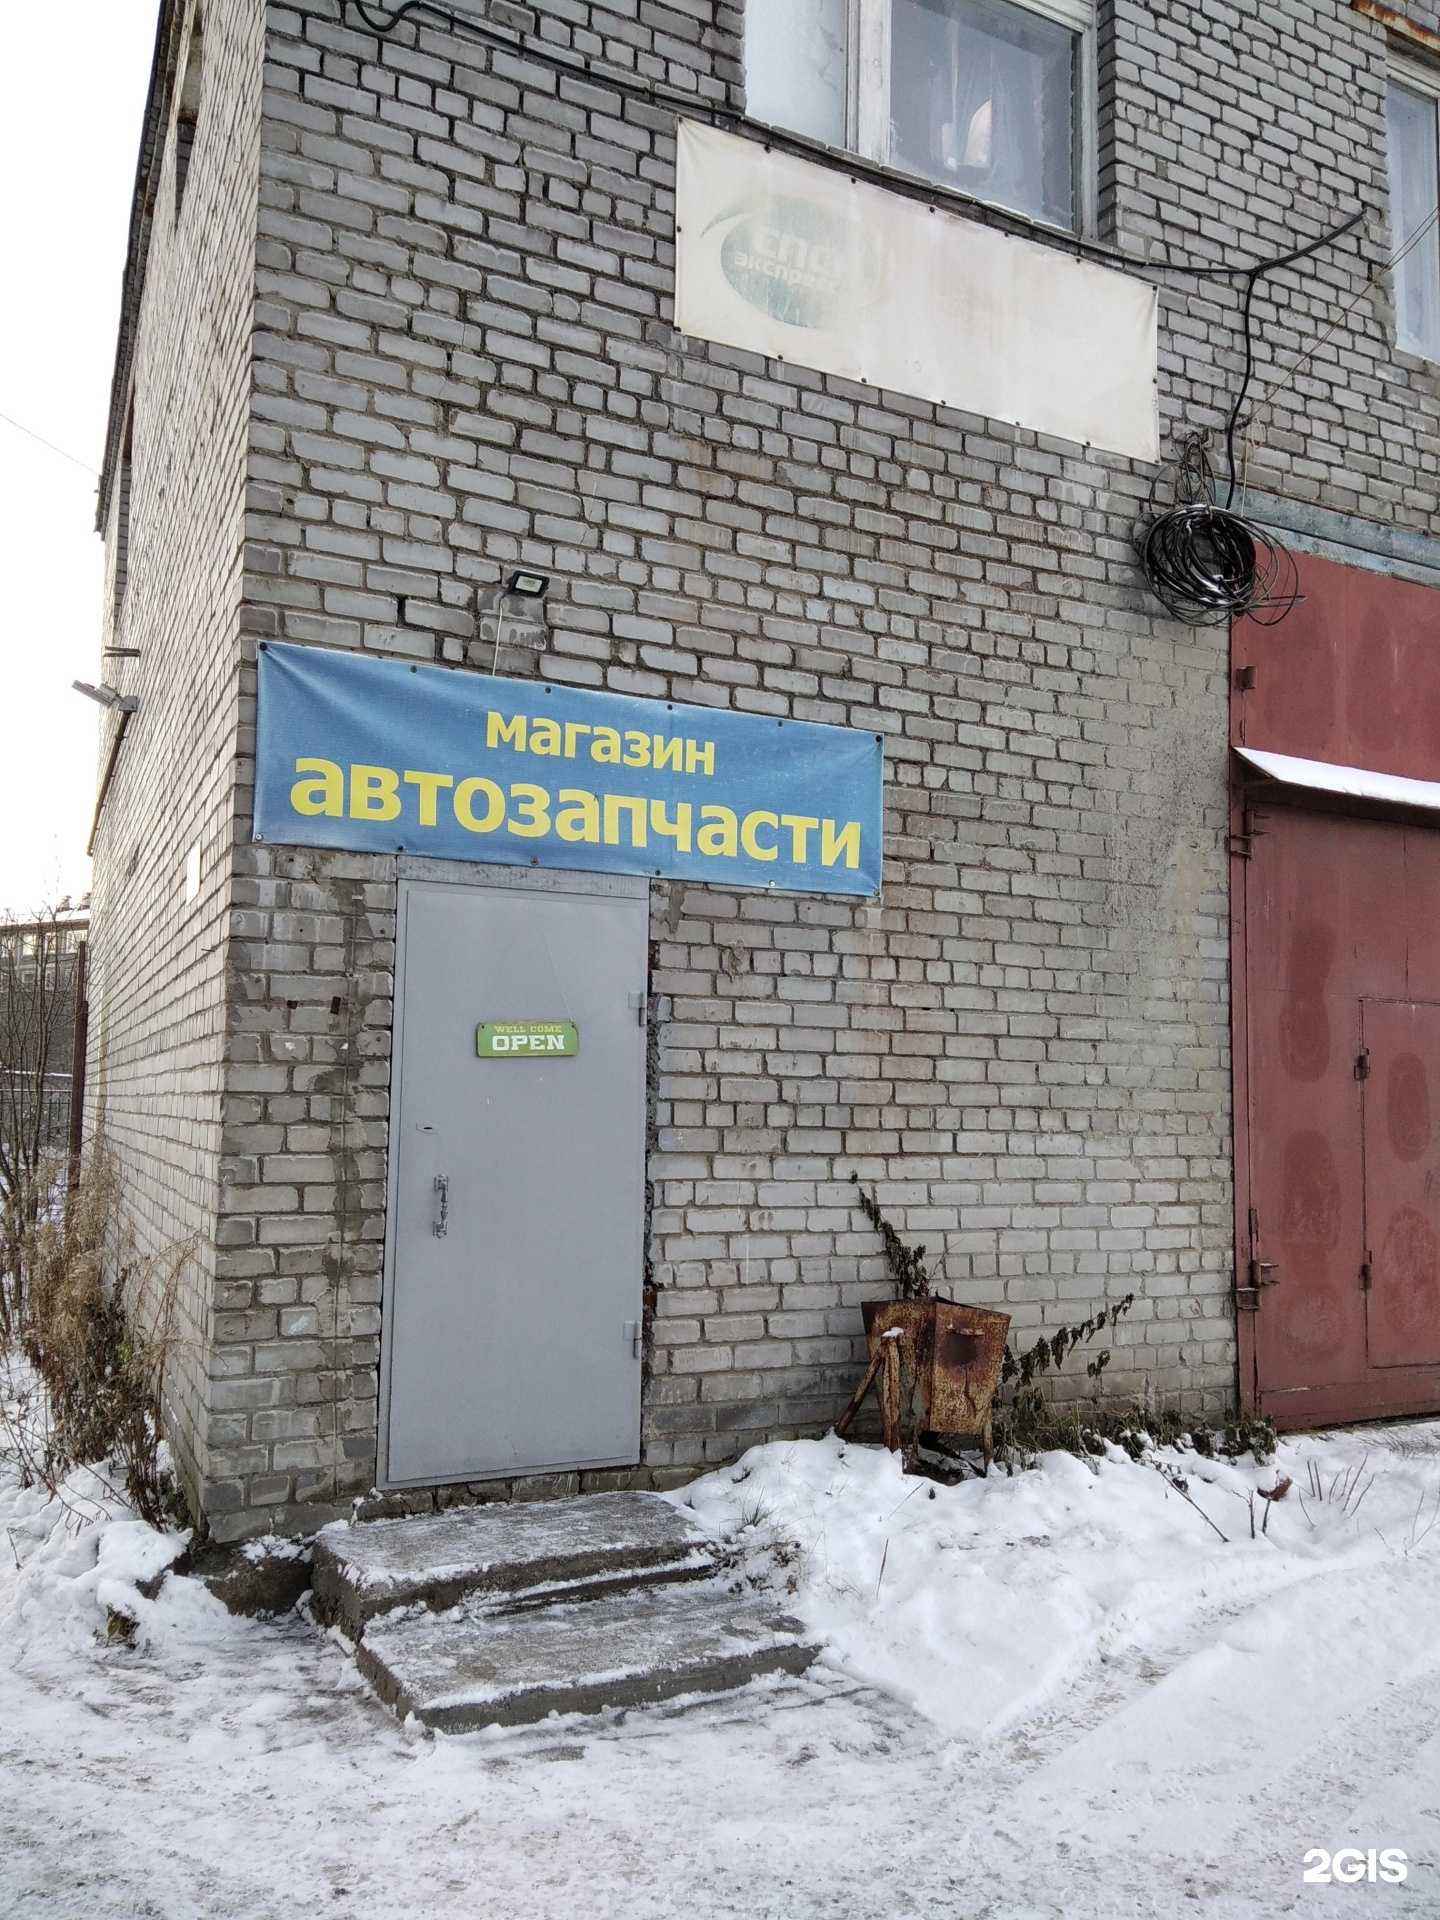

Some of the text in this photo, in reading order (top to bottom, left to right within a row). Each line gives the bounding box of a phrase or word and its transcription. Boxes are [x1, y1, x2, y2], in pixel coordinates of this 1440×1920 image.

[486, 711, 715, 775] магазин
[290, 757, 861, 869] автозапчасти
[492, 1035, 565, 1051] OPEN
[494, 1025, 562, 1033] WELL COME
